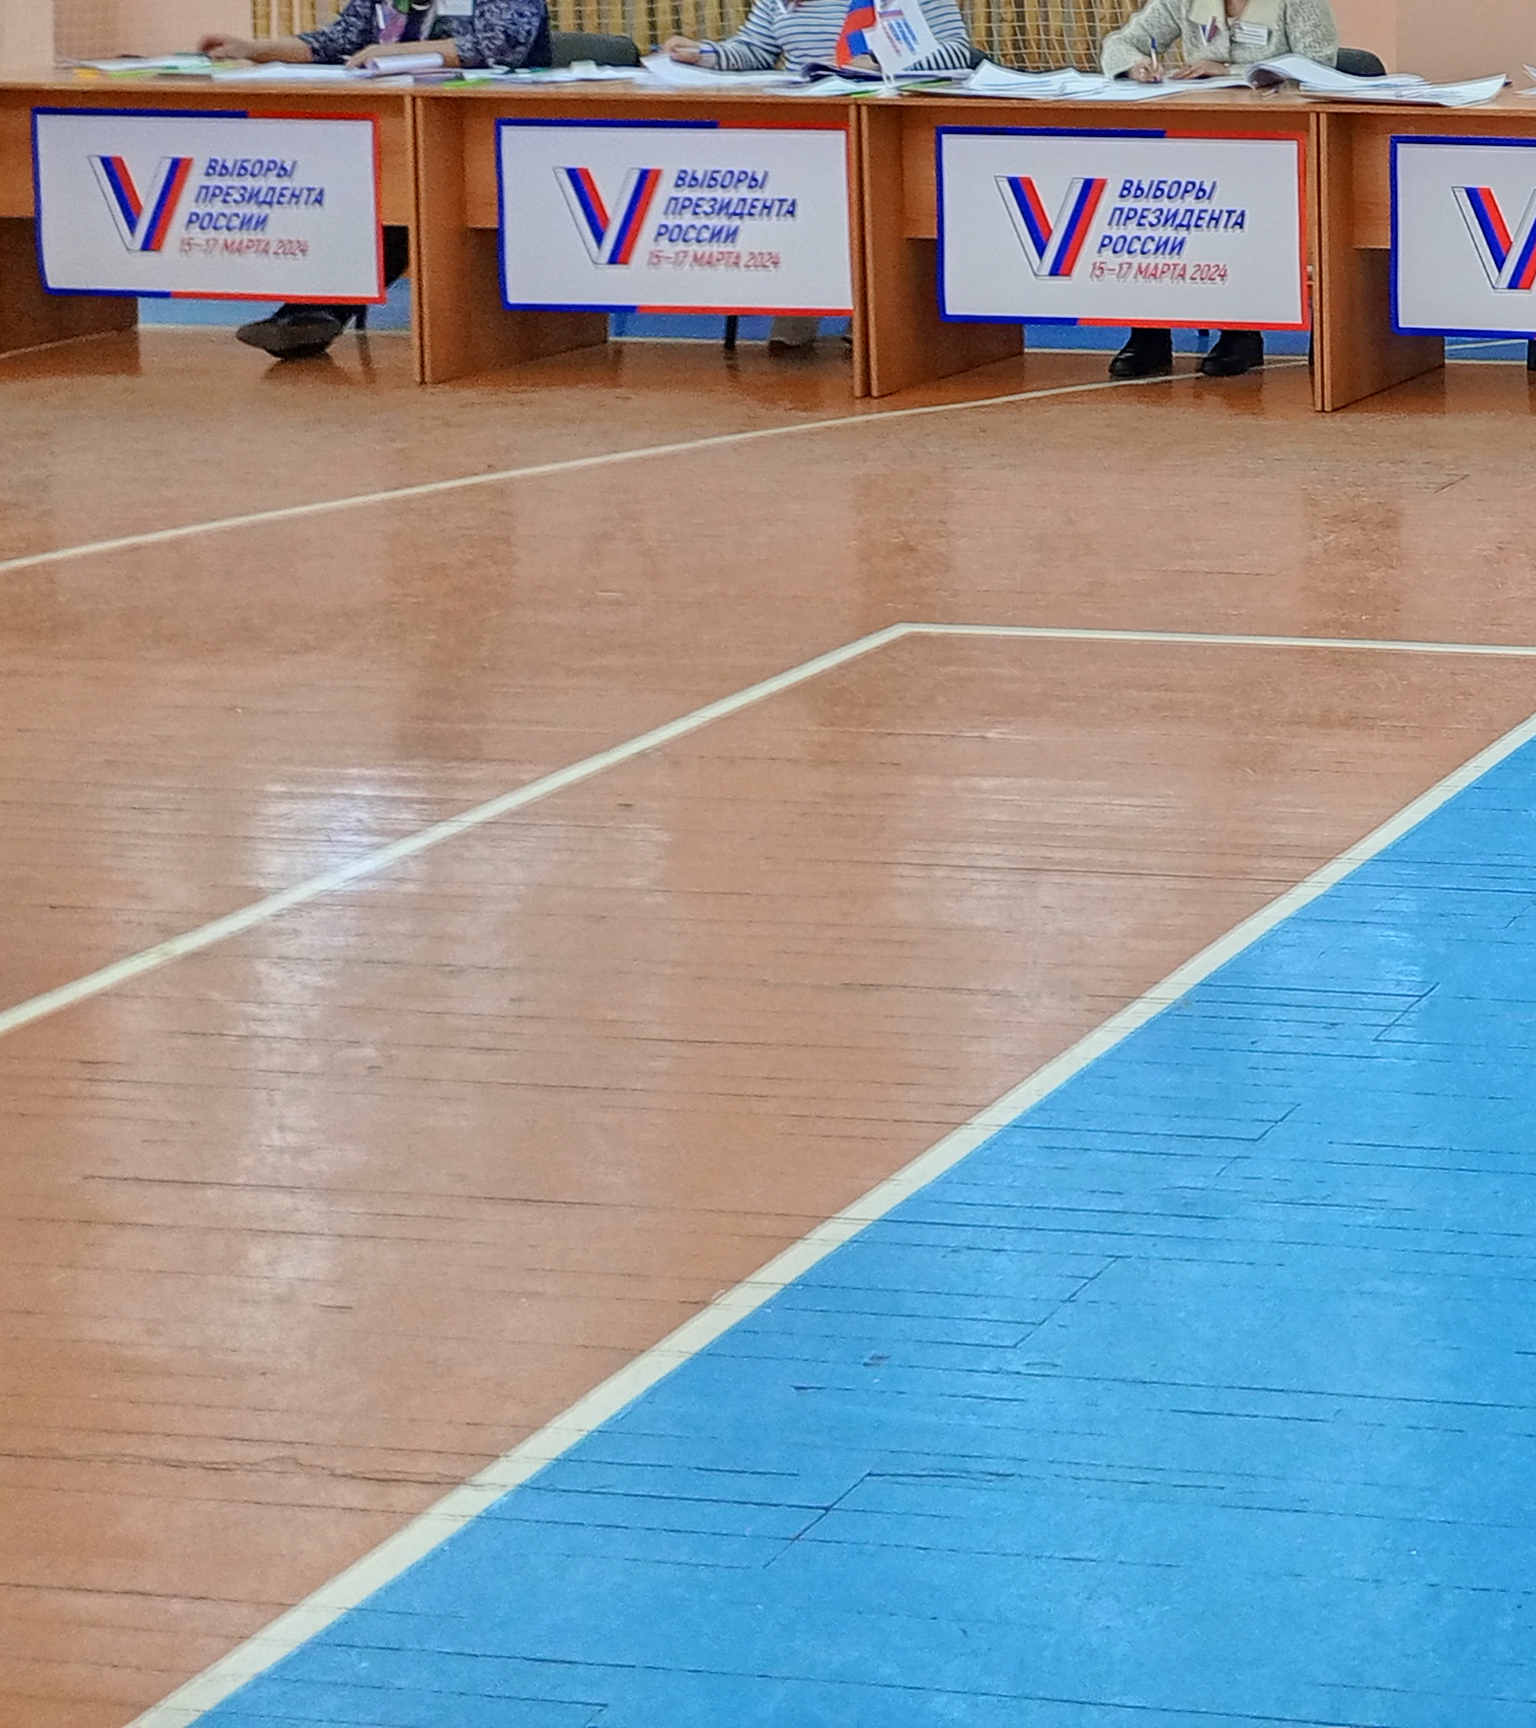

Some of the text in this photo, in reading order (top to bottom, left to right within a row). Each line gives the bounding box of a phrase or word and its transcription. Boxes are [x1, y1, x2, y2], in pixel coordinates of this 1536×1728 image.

[204, 158, 297, 178] ВЫБОРЫ
[674, 169, 769, 190] ВЫБОРЫ
[1119, 179, 1218, 200] ВЫБОРЫ
[195, 185, 325, 207] ПРЕЗИДЕНТА
[664, 196, 797, 219] ПРЕЗИДЕНТА
[186, 212, 269, 232] РОССИИ
[1108, 207, 1246, 231] ПРЕЗИДЕНТА
[654, 224, 740, 244] РОССИИ
[220, 239, 271, 255] МАРТА
[273, 241, 309, 257] 2024
[1097, 235, 1187, 255] РОССИИ
[689, 251, 741, 268] МАРТА
[743, 252, 781, 268] 2024
[1135, 263, 1188, 280] МАРТА
[1190, 264, 1228, 282] 2024
